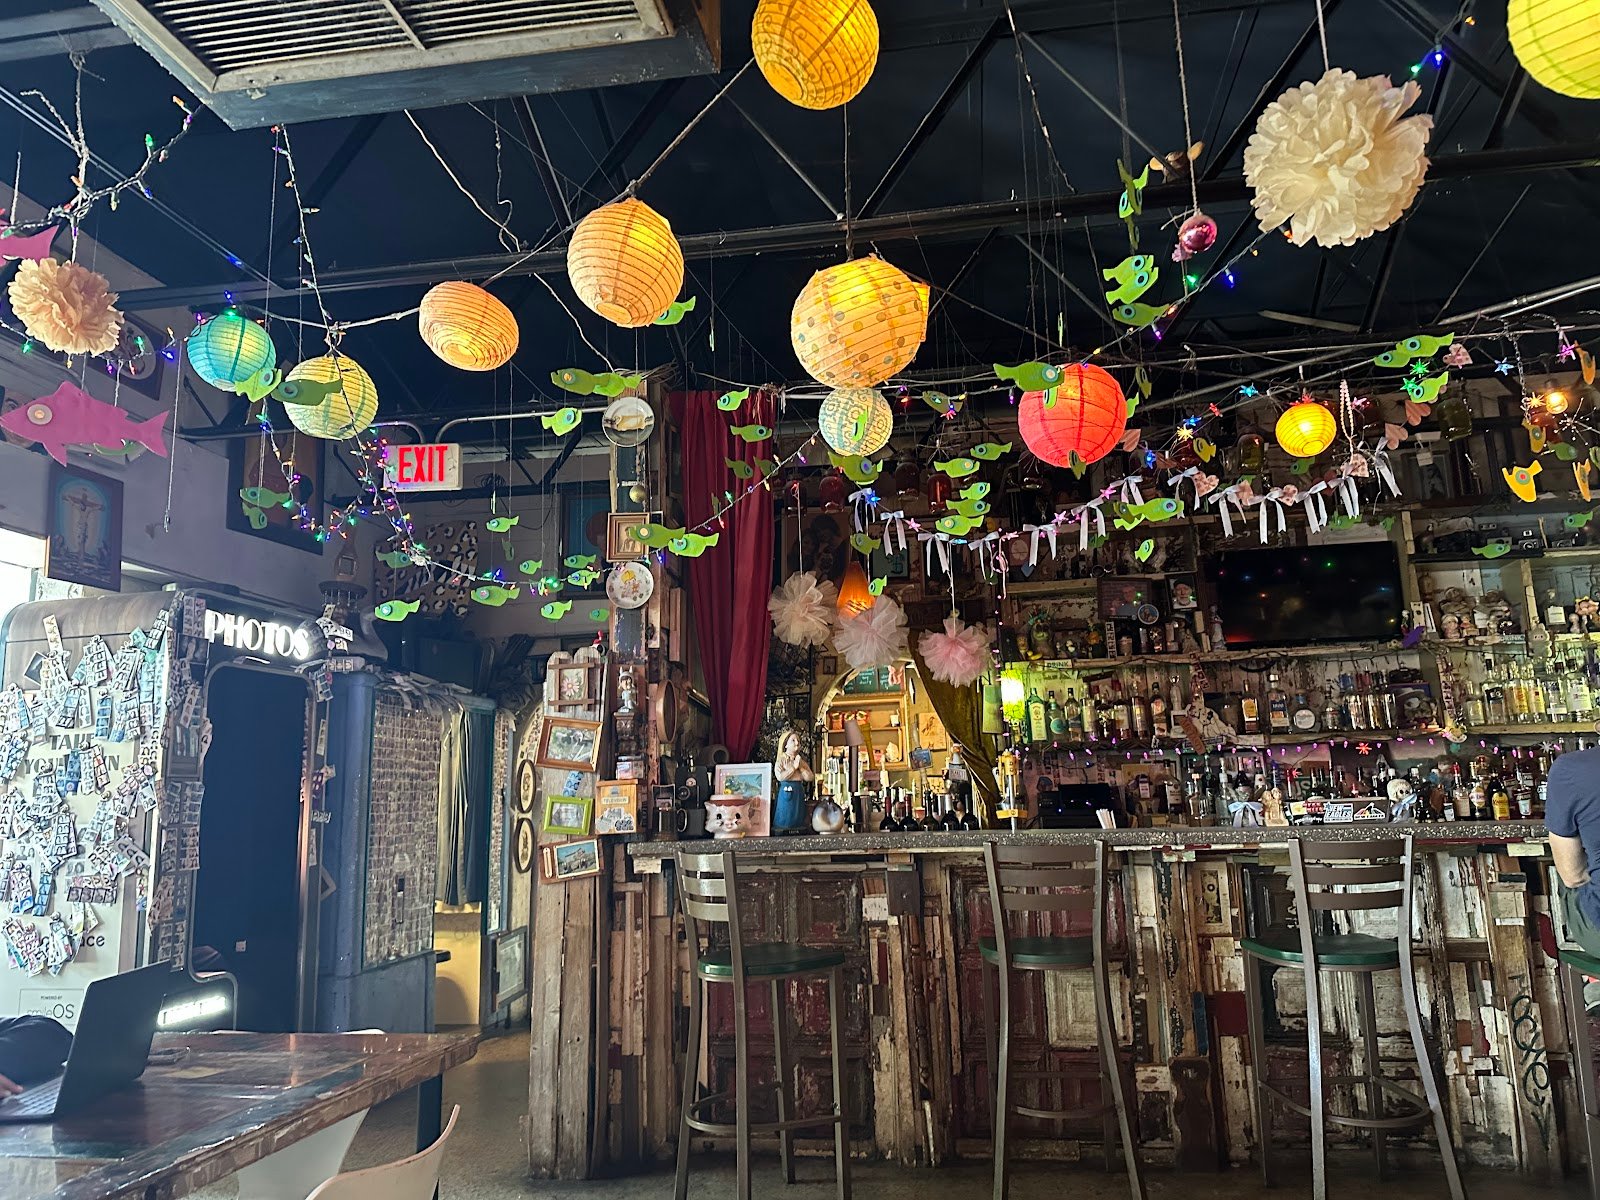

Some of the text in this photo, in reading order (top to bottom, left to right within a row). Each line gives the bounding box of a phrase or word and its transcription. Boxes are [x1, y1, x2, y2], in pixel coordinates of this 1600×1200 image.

[398, 445, 448, 483] EXIT
[204, 608, 309, 660] PHOTOS
[1329, 804, 1344, 812] NEW
